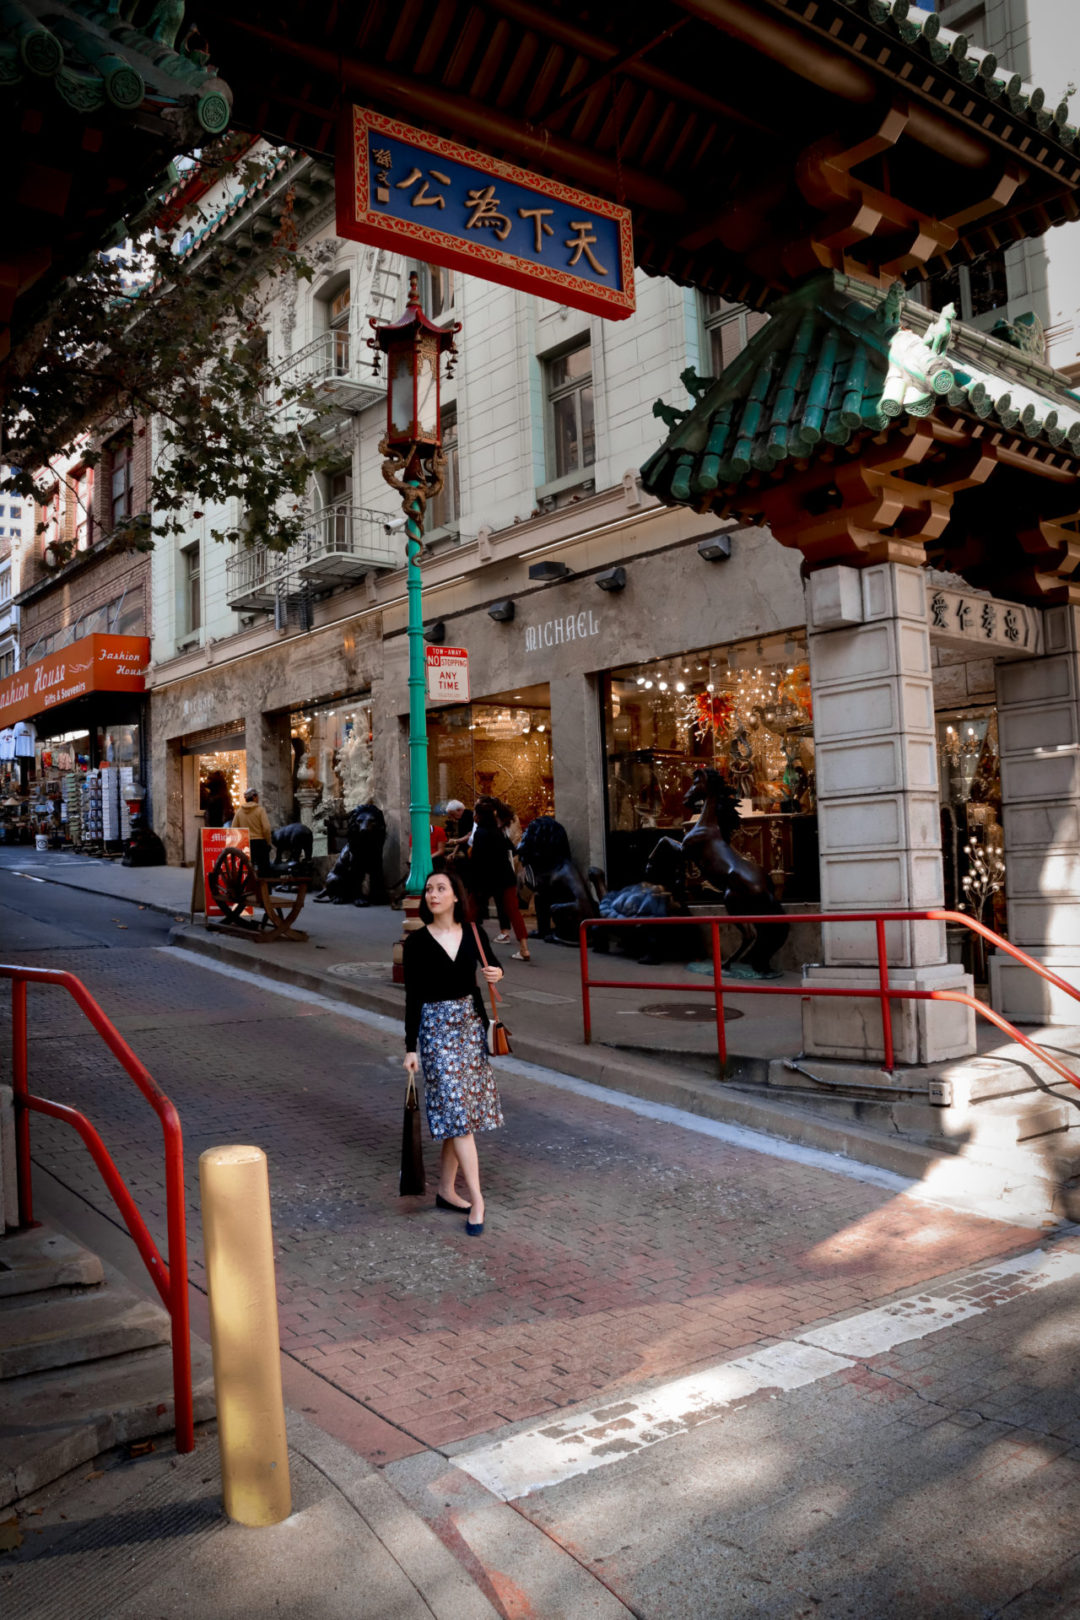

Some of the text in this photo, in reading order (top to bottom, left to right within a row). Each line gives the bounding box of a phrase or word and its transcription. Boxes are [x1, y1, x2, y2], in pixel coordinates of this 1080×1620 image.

[525, 610, 600, 653] MICHAEL
[98, 648, 140, 661] Fashion
[427, 655, 440, 666] NO
[116, 664, 142, 677] Hous
[440, 671, 457, 680] ANY
[0, 664, 66, 709] ashion House
[439, 681, 460, 691] TIME
[44, 693, 57, 706] Gifts
[61, 681, 86, 700] Souvenirs
